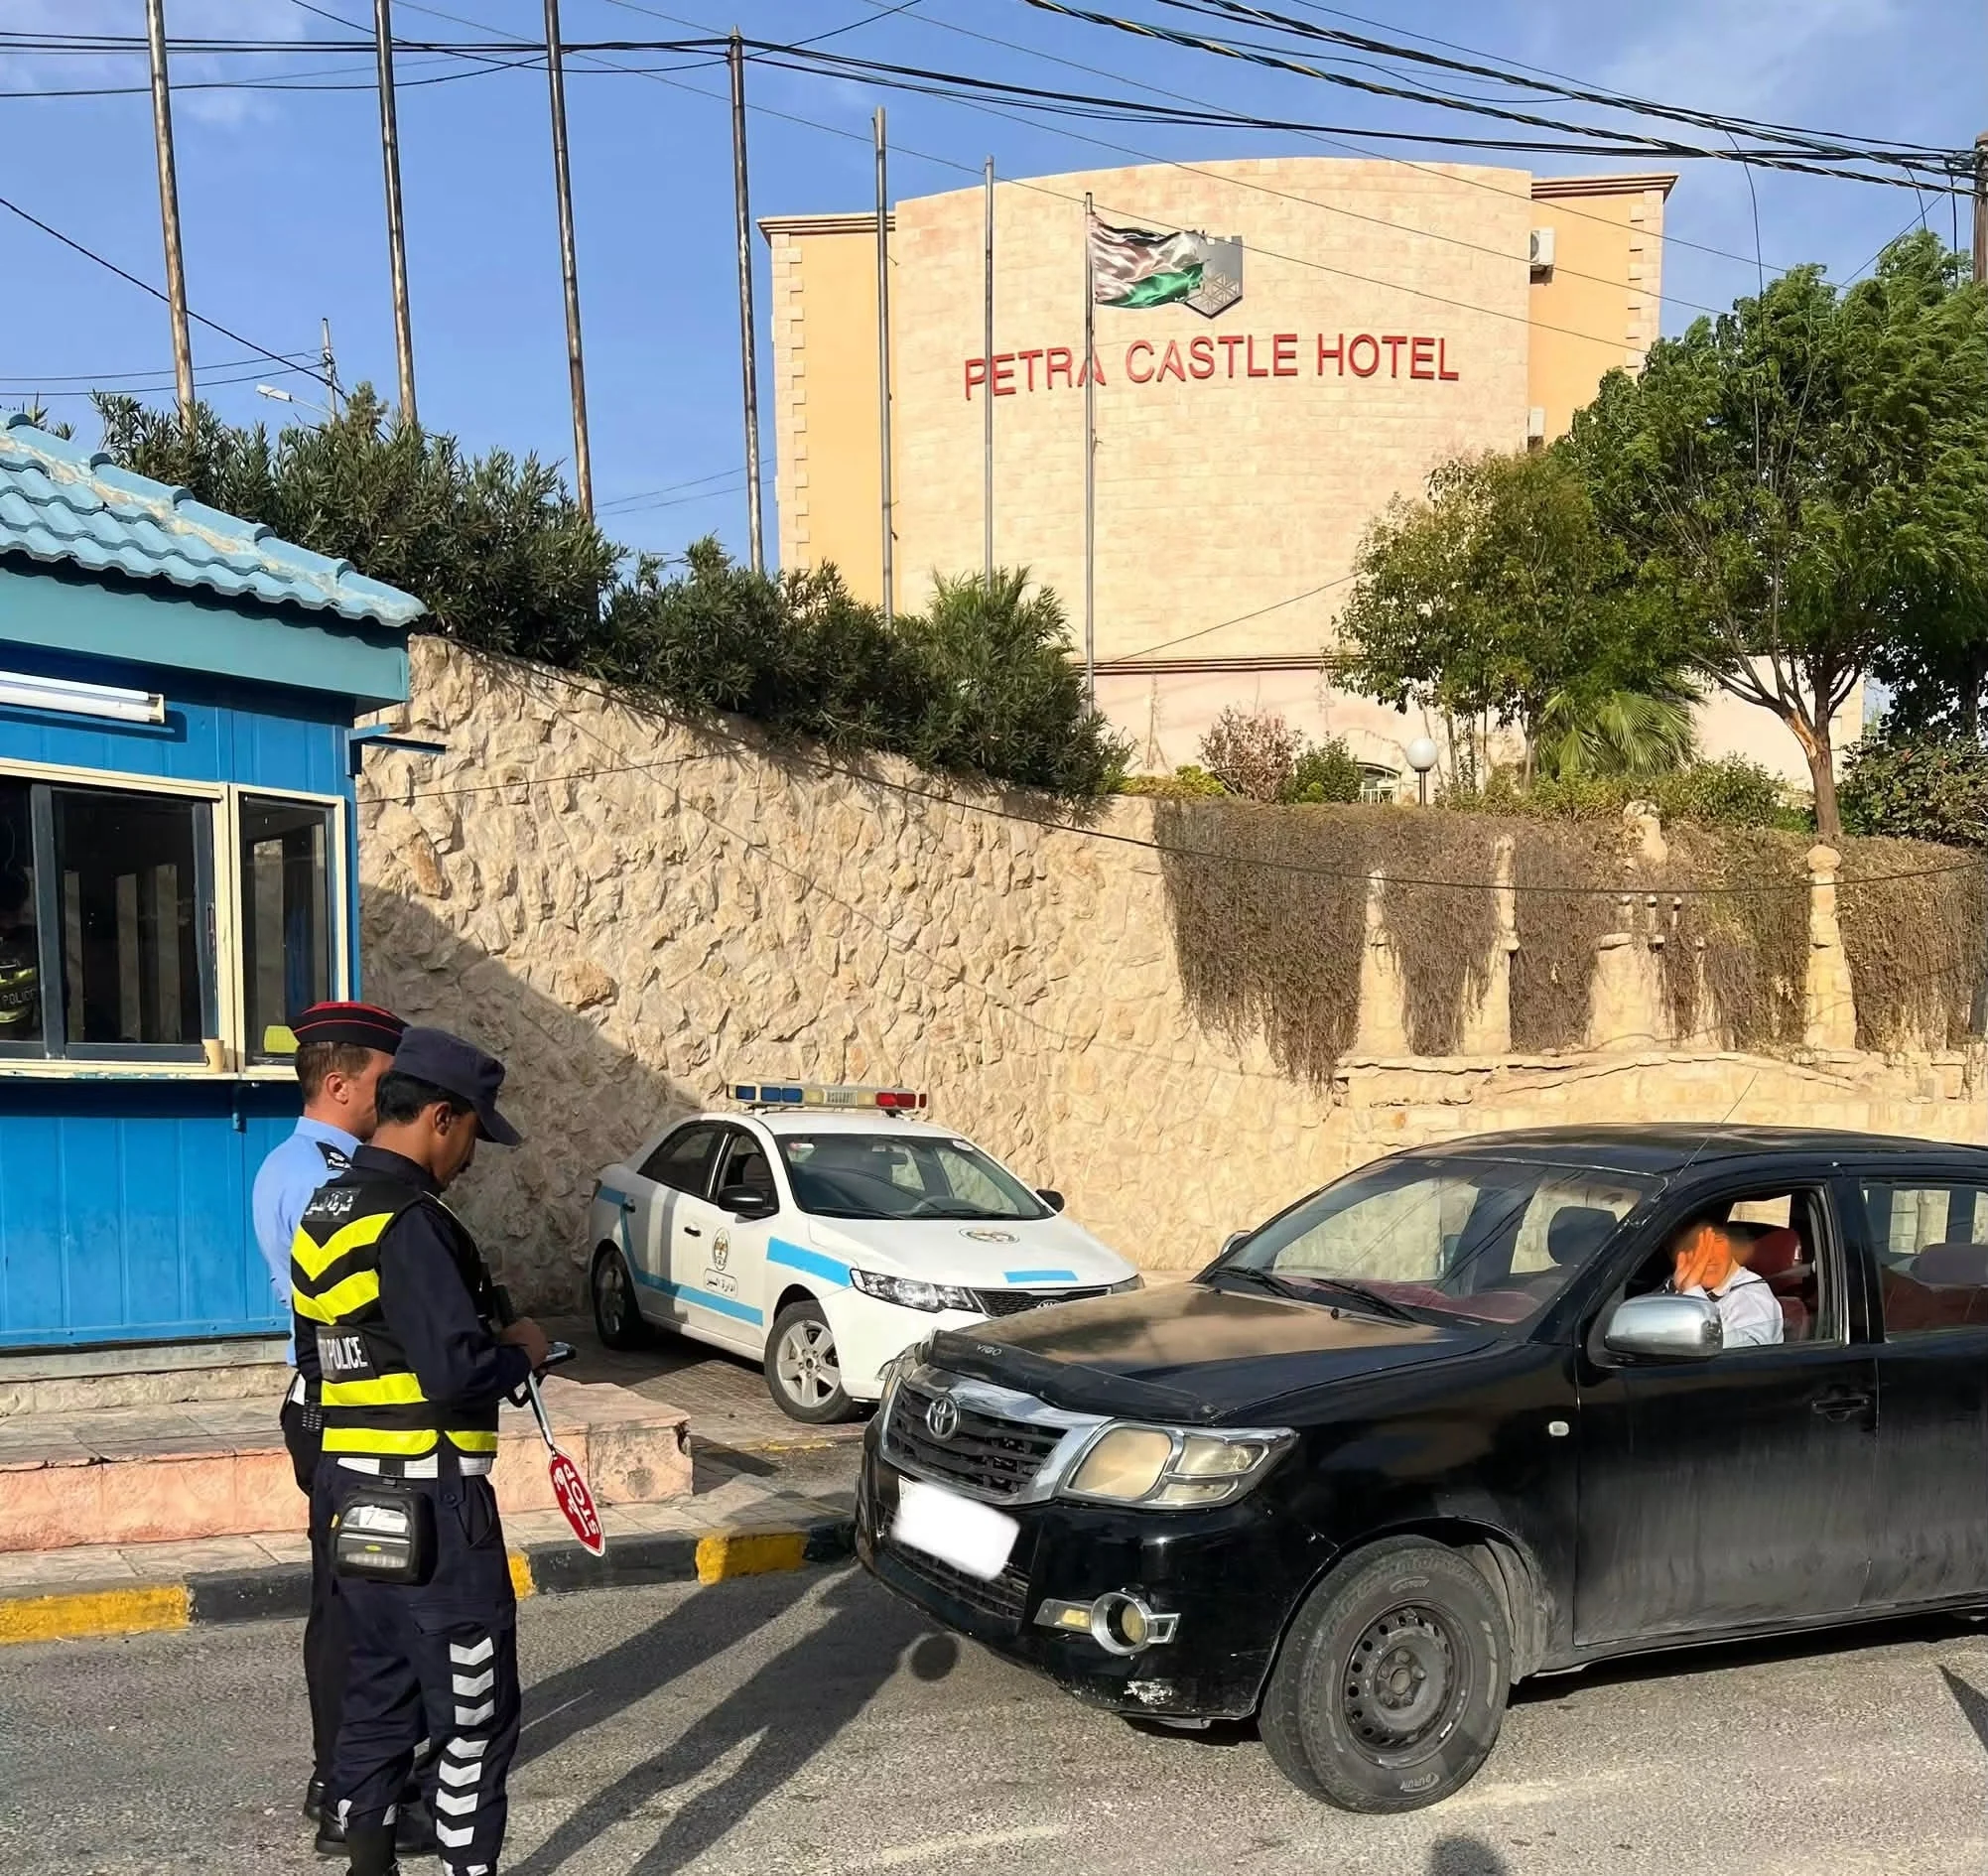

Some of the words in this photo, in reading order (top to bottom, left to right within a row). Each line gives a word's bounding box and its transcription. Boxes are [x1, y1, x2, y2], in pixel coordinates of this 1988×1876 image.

[965, 344, 1107, 400] PETRA
[1125, 333, 1299, 383] CASTLE
[1316, 332, 1460, 381] HOTEL
[2, 989, 37, 1005] POLIC
[326, 1336, 368, 1370] POLICE
[563, 1463, 597, 1536] STOP
